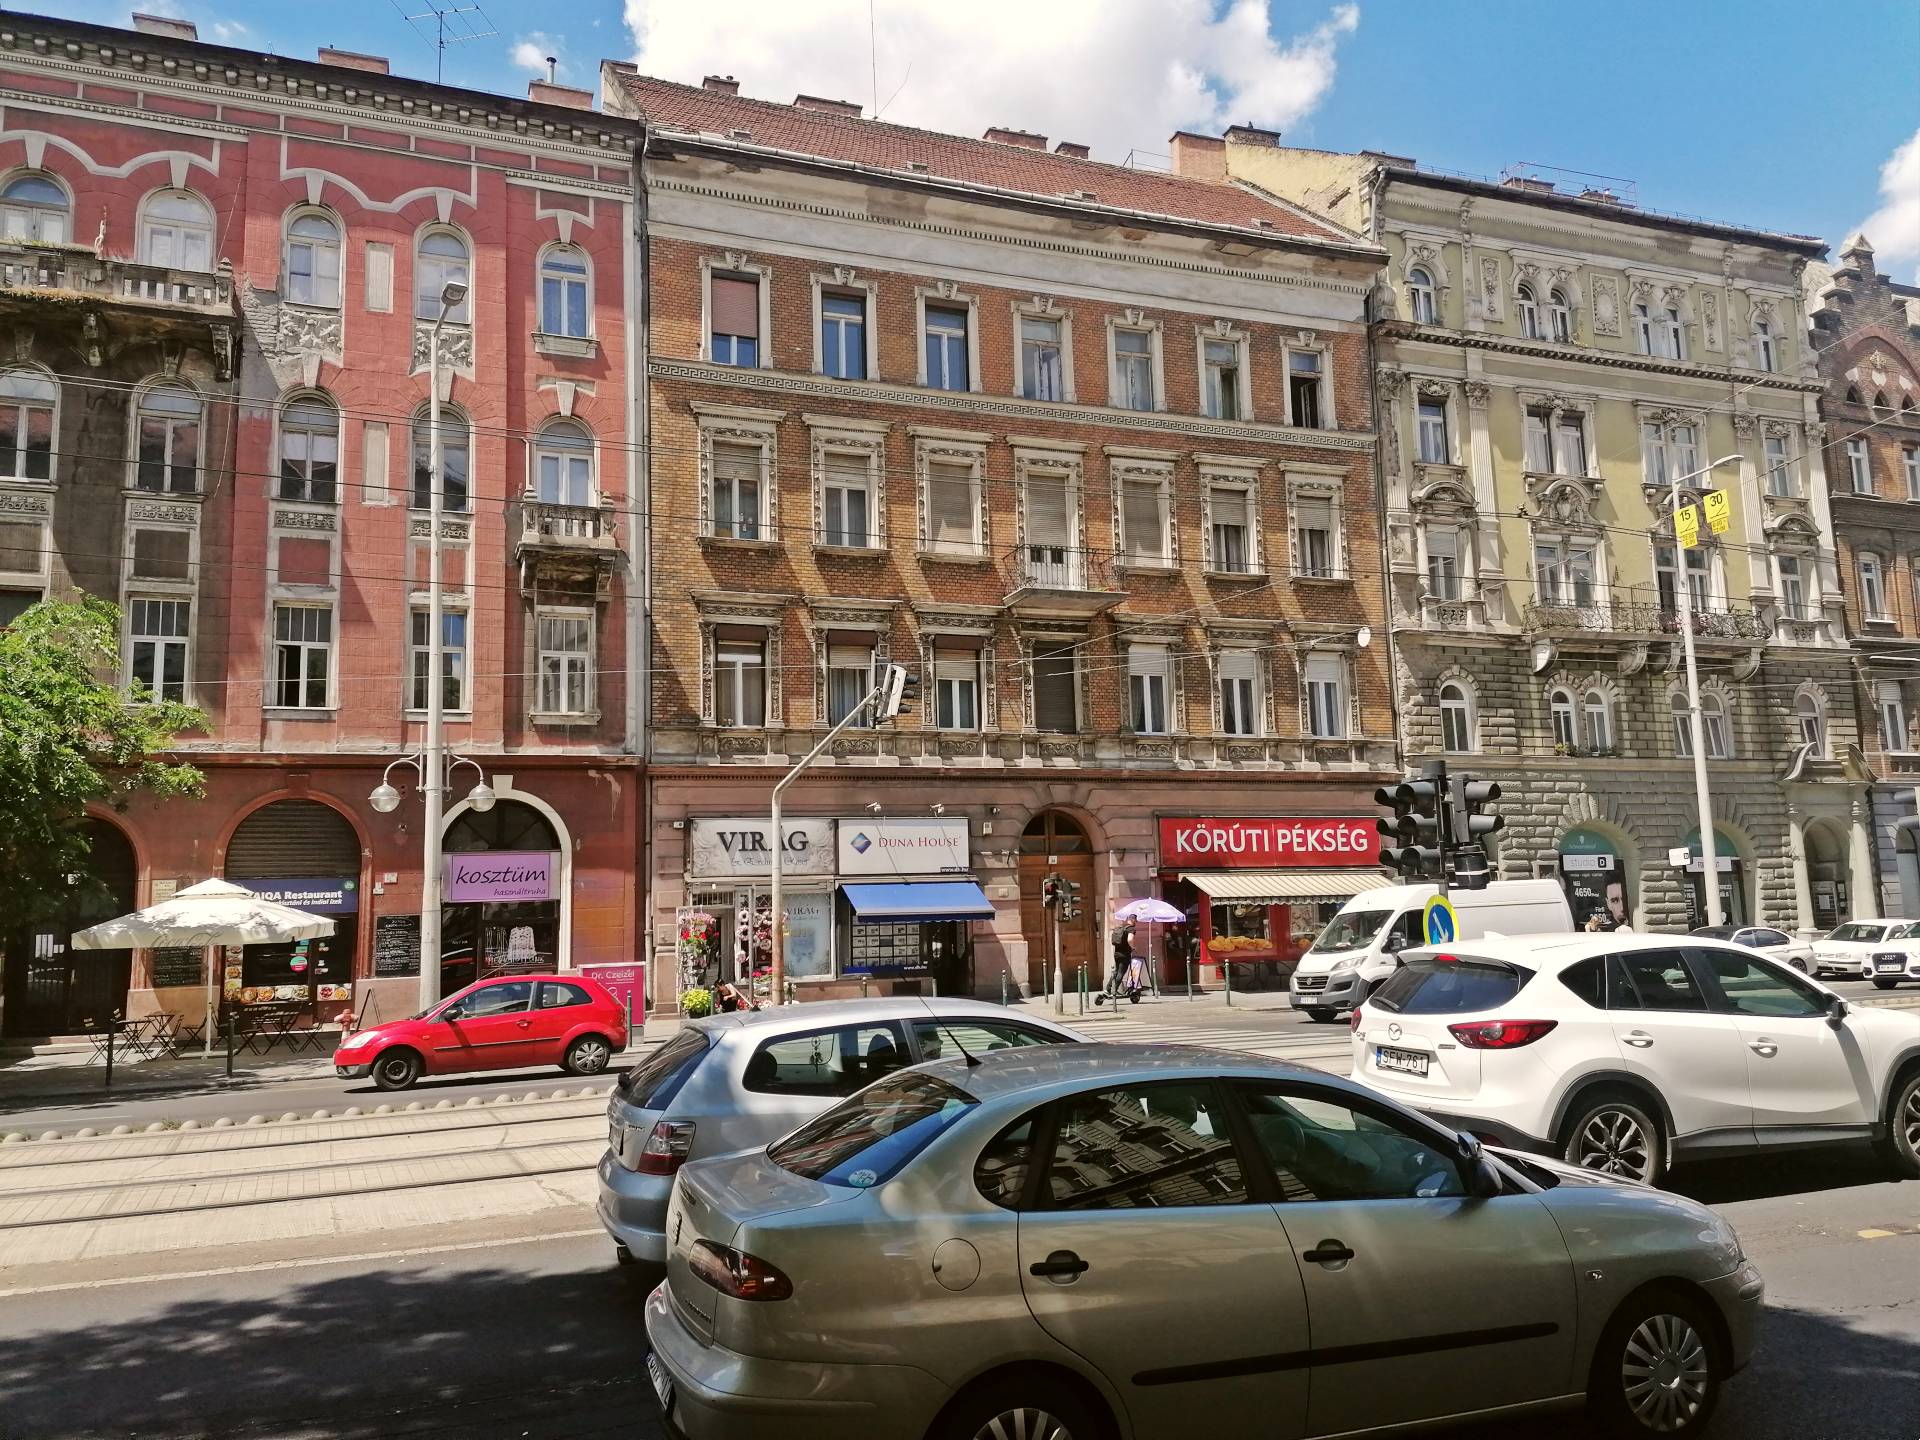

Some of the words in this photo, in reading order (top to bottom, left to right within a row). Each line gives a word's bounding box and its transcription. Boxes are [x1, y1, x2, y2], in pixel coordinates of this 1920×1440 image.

[1710, 494, 1722, 506] 30
[1680, 510, 1690, 522] 15
[879, 837, 914, 848] DUNA
[918, 837, 958, 847] HOUSE
[1176, 823, 1270, 852] KÖRÚTI
[1277, 823, 1368, 852] PÉKSÉG
[456, 865, 546, 884] kosztüm
[284, 890, 342, 900] Restaurant
